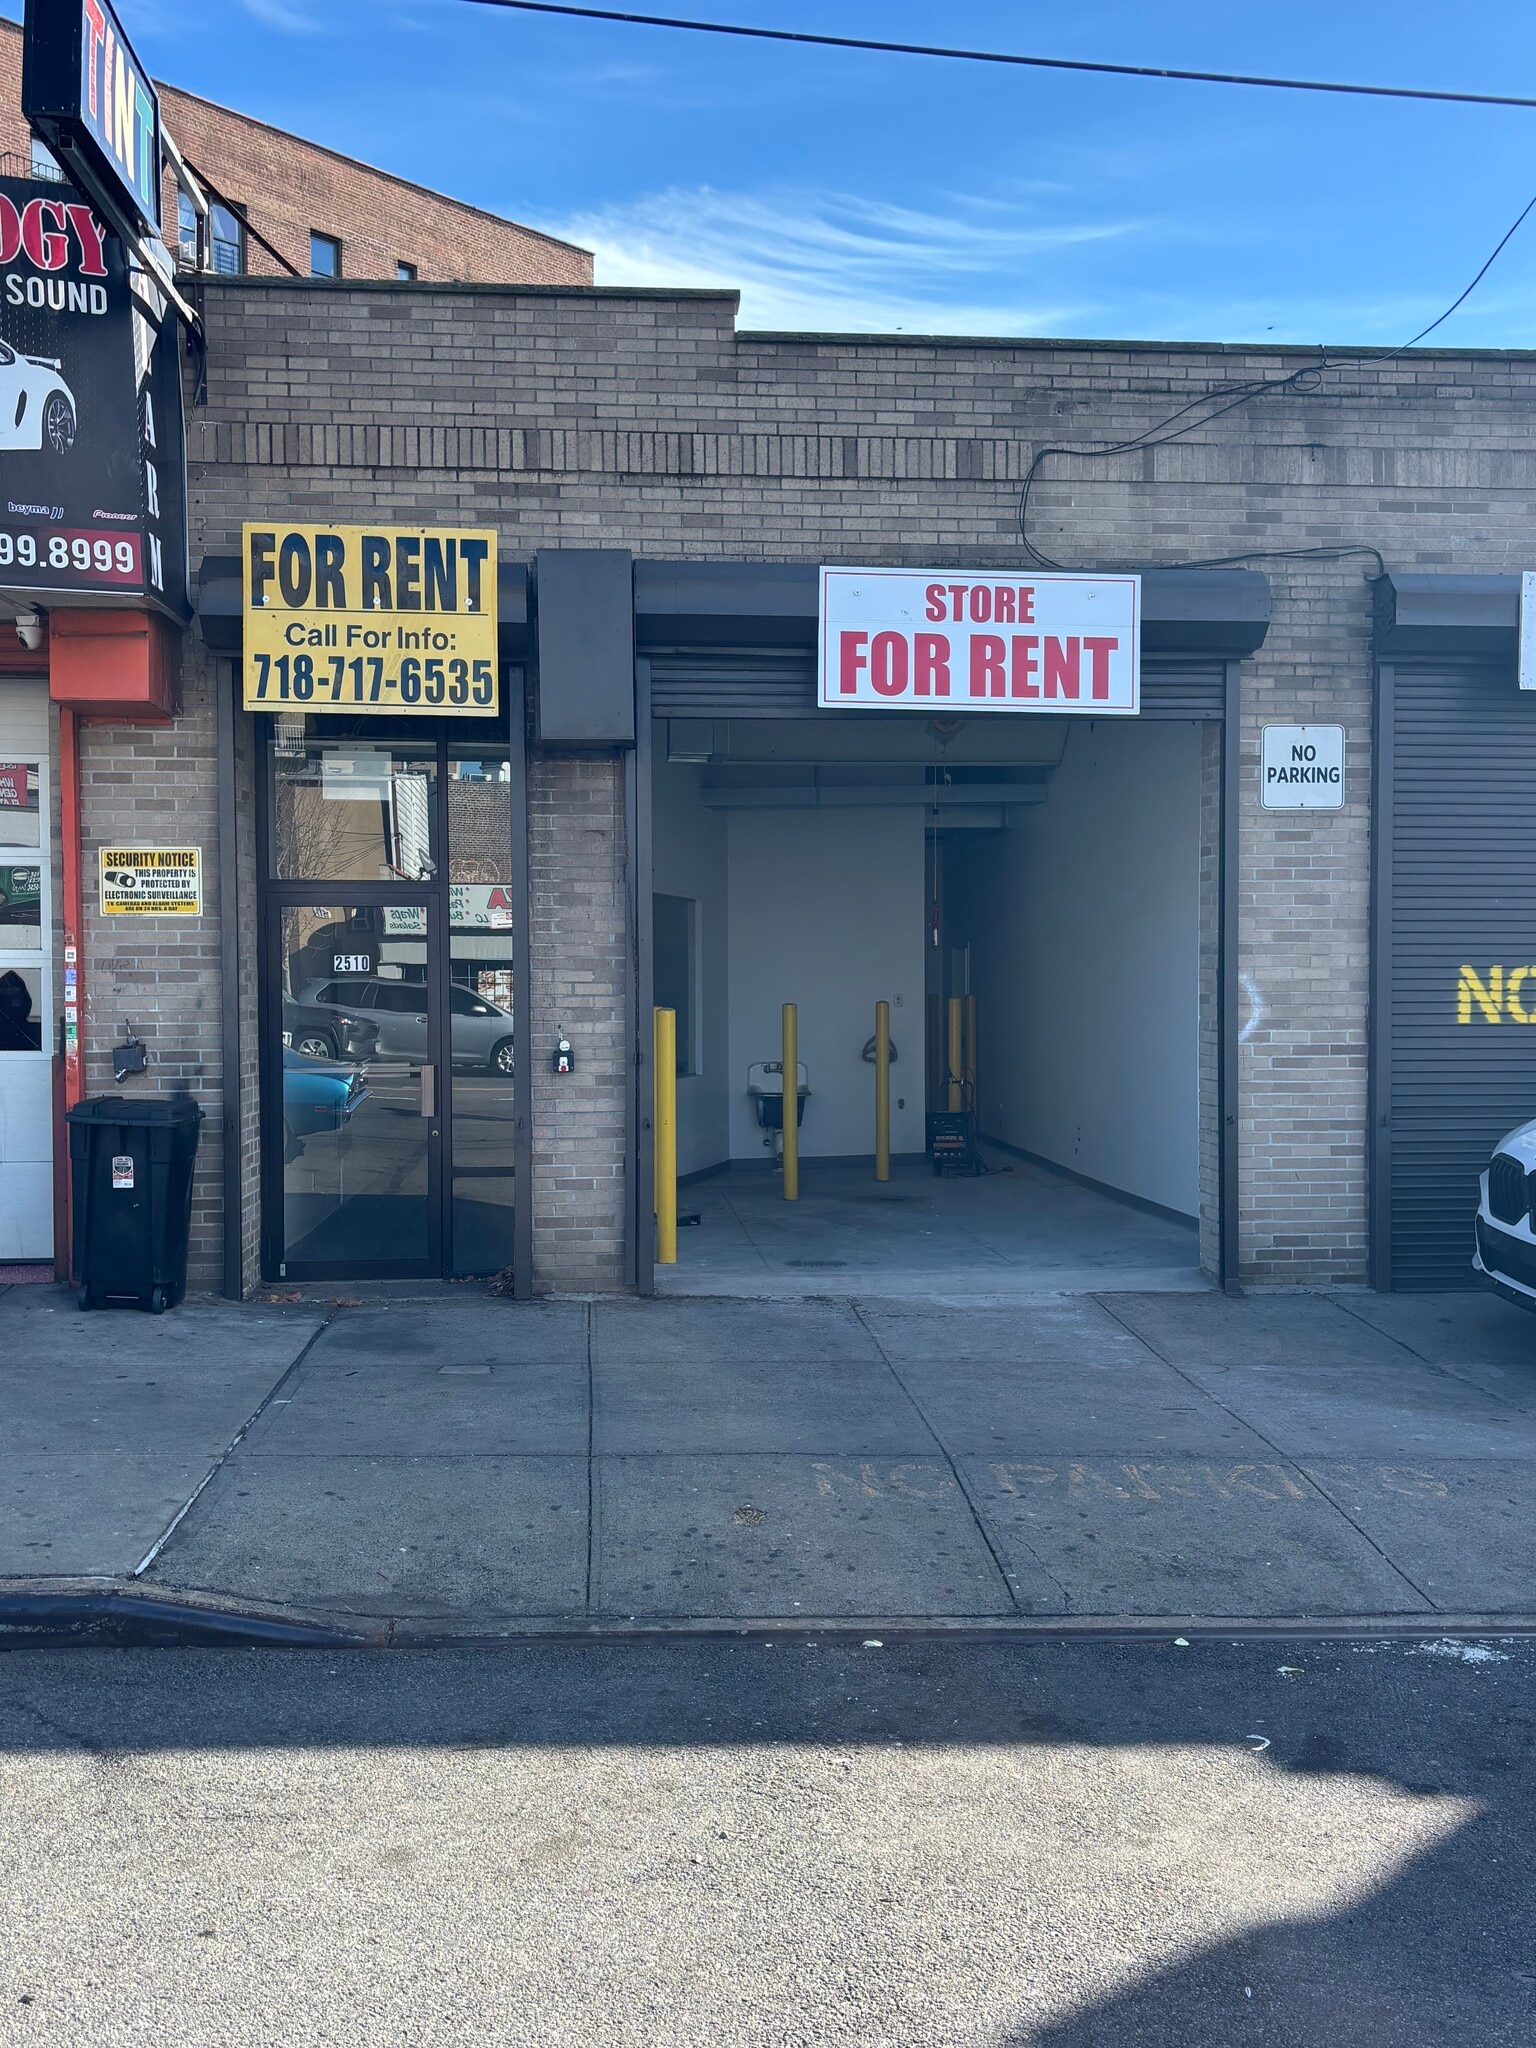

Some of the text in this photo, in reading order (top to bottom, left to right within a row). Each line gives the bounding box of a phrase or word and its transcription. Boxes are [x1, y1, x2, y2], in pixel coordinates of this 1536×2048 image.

[85, 0, 154, 206] TINT
[6, 274, 107, 315] SOUND
[8, 501, 50, 516] beyma
[93, 509, 138, 521] Pioneer
[250, 532, 489, 613] FOR RENT
[925, 583, 1035, 624] STORE
[285, 622, 456, 651] Call For Info:
[840, 630, 1119, 700] FOR RENT
[253, 653, 493, 705] 718-717-6535
[1291, 744, 1317, 762] NO
[1266, 766, 1340, 784] PARKING
[106, 852, 194, 867] SECURITY NOTICE
[134, 868, 196, 878] THIS PROPERTY IS
[141, 879, 191, 888] PROTECTED BY
[104, 890, 197, 900] ELECTRONIC SURVEILLANCE
[335, 956, 368, 970] 2510
